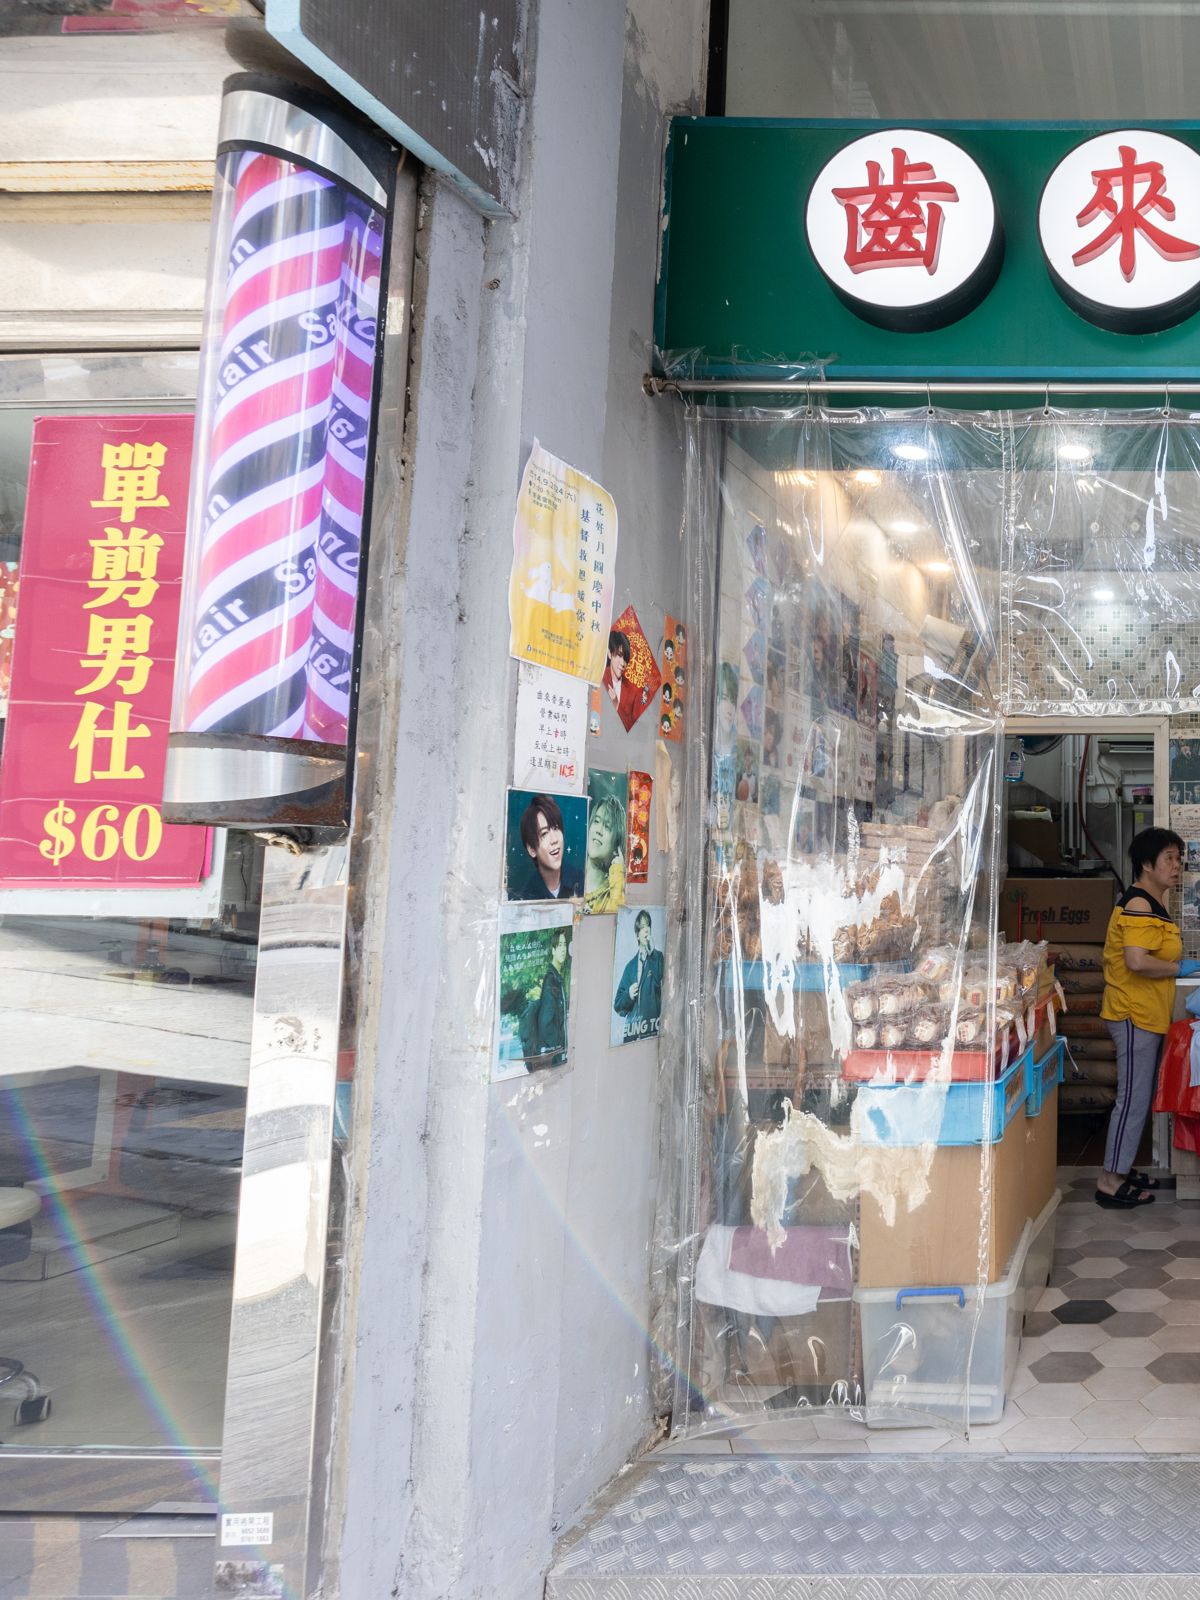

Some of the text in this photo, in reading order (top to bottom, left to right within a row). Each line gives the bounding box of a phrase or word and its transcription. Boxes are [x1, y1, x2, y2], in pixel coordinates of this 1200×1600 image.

[69, 441, 170, 784] 單剪男仕
[590, 503, 605, 632] 花好月圓慶中秋
[39, 799, 162, 866] $60
[1060, 906, 1091, 925] Eggs
